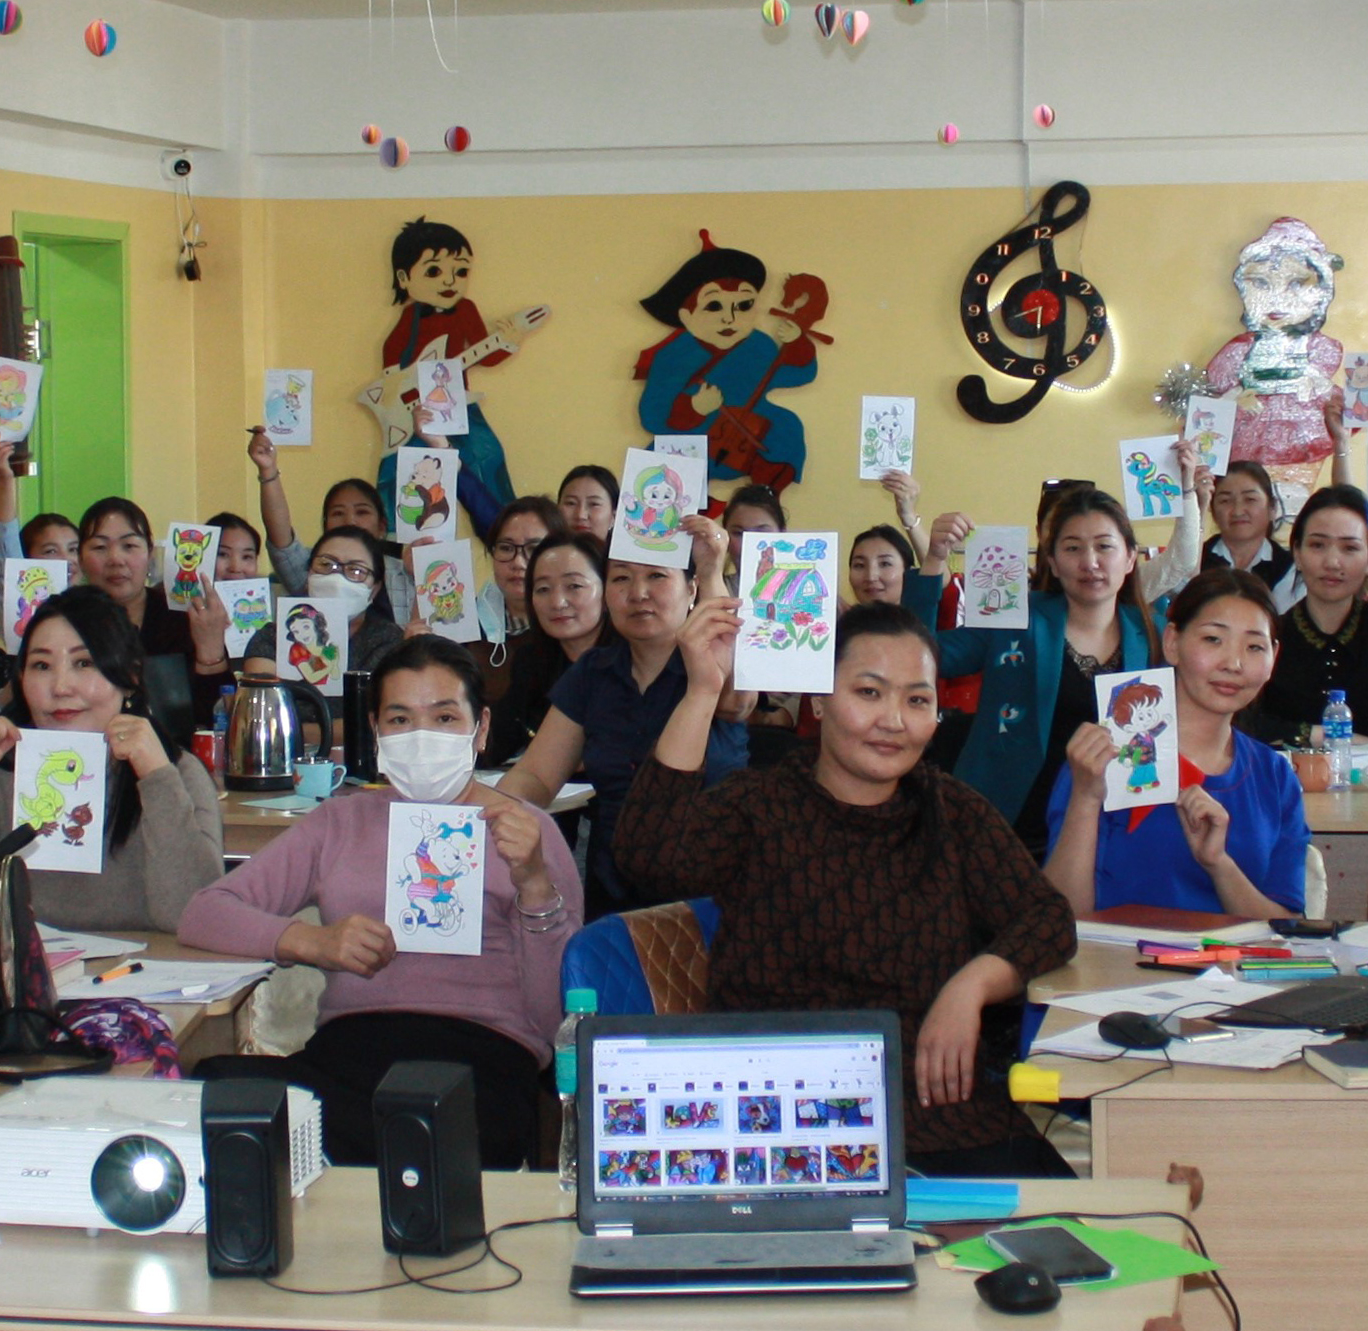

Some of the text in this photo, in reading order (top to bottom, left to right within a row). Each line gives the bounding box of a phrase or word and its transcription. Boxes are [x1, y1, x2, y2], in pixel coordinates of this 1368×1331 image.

[1033, 226, 1053, 240] 12
[997, 244, 1010, 256] 11
[1061, 271, 1069, 282] 1
[1079, 283, 1093, 295] 2
[968, 305, 980, 316] 9
[1093, 305, 1105, 318] 3
[976, 332, 990, 344] 8
[1085, 333, 1098, 346] 4
[1003, 357, 1016, 370] 7
[1067, 355, 1080, 367] 5
[1033, 363, 1046, 376] 6
[21, 1168, 51, 1178] acer
[732, 1205, 752, 1214] DELL
